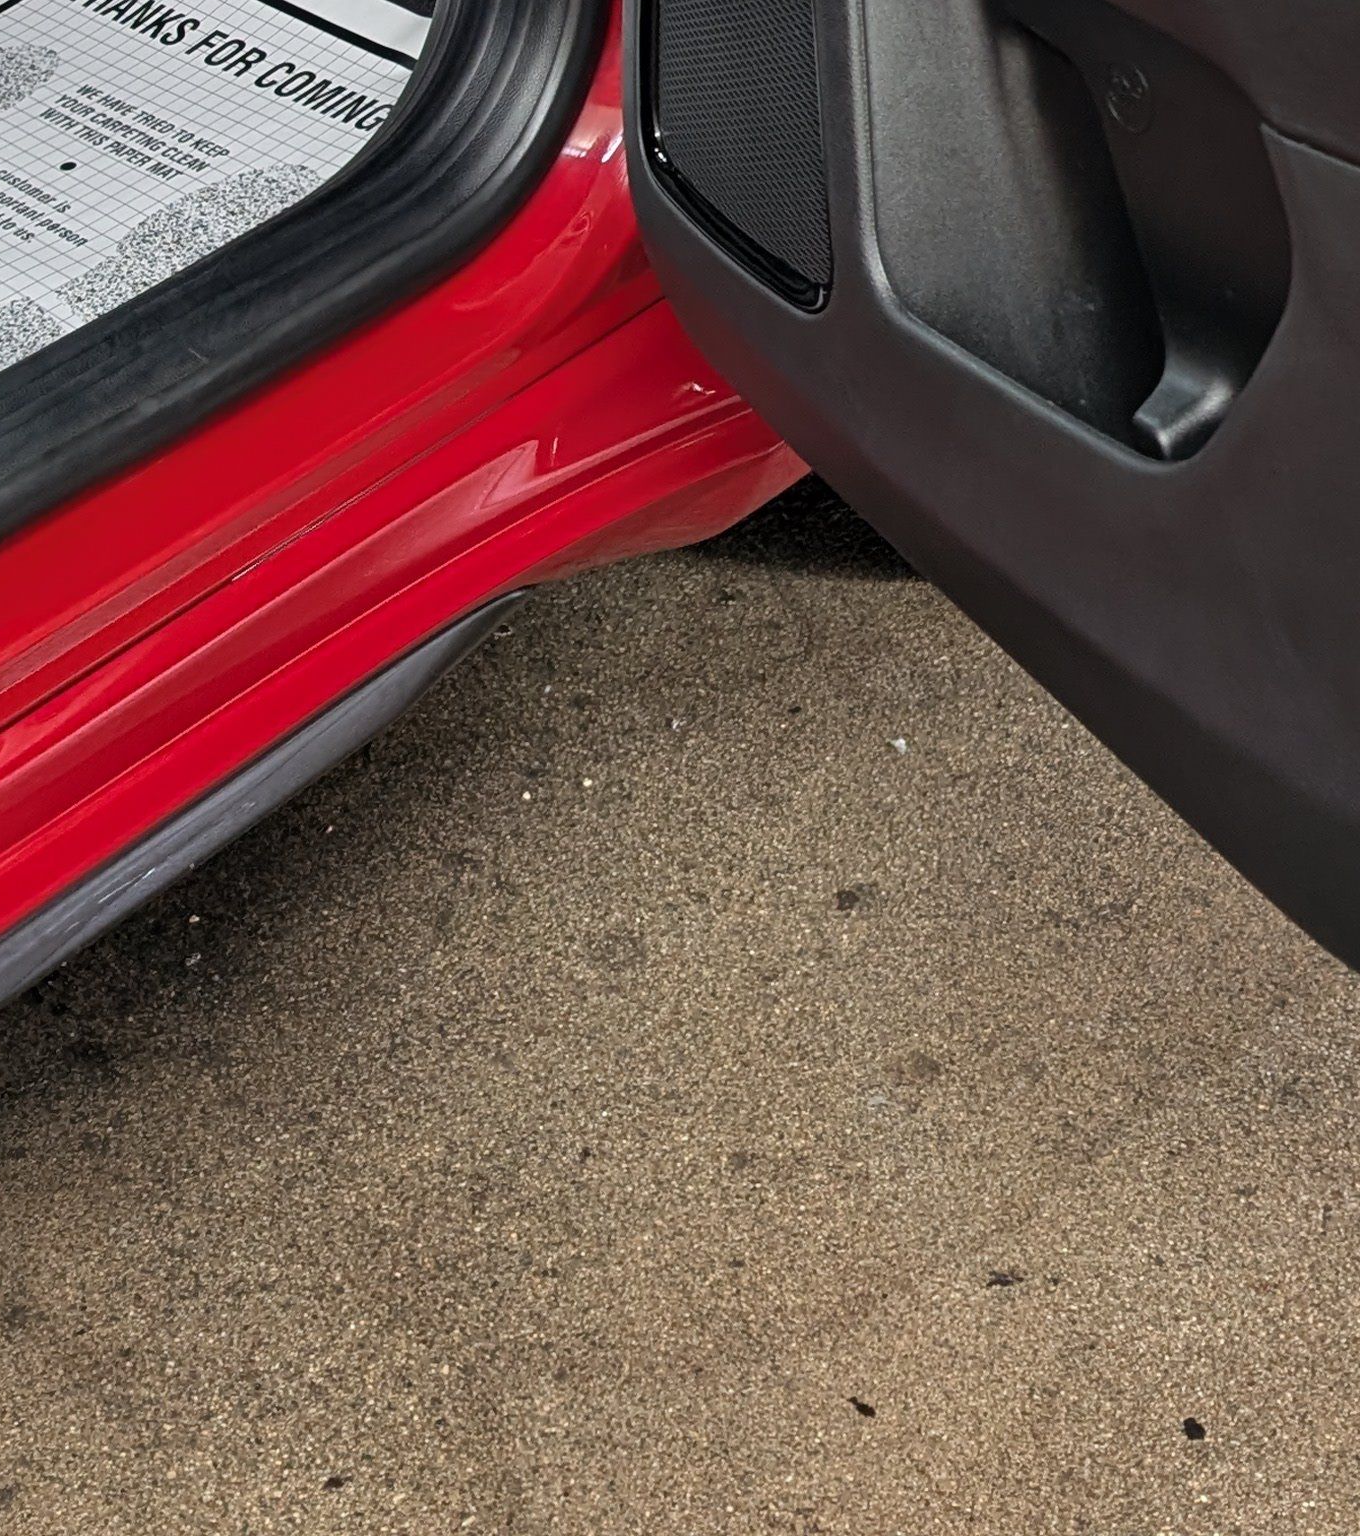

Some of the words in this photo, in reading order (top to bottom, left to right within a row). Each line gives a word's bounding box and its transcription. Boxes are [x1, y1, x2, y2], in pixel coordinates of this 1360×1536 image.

[185, 30, 268, 78] FOR
[254, 62, 396, 131] COMING
[40, 107, 77, 131] WITH
[73, 124, 110, 146] THIS
[103, 141, 153, 167] PAPER
[147, 162, 183, 181] MAT
[54, 94, 96, 118] YOUR
[90, 113, 167, 152] CARPETING
[161, 146, 211, 173] CLEAN
[76, 84, 103, 100] WE
[97, 95, 138, 117] HAVE
[132, 110, 175, 134] TRIED
[173, 129, 195, 144] TO
[192, 138, 231, 159] KEEP
[13, 227, 36, 244] us.
[35, 217, 88, 248] person
[52, 200, 71, 214] is
